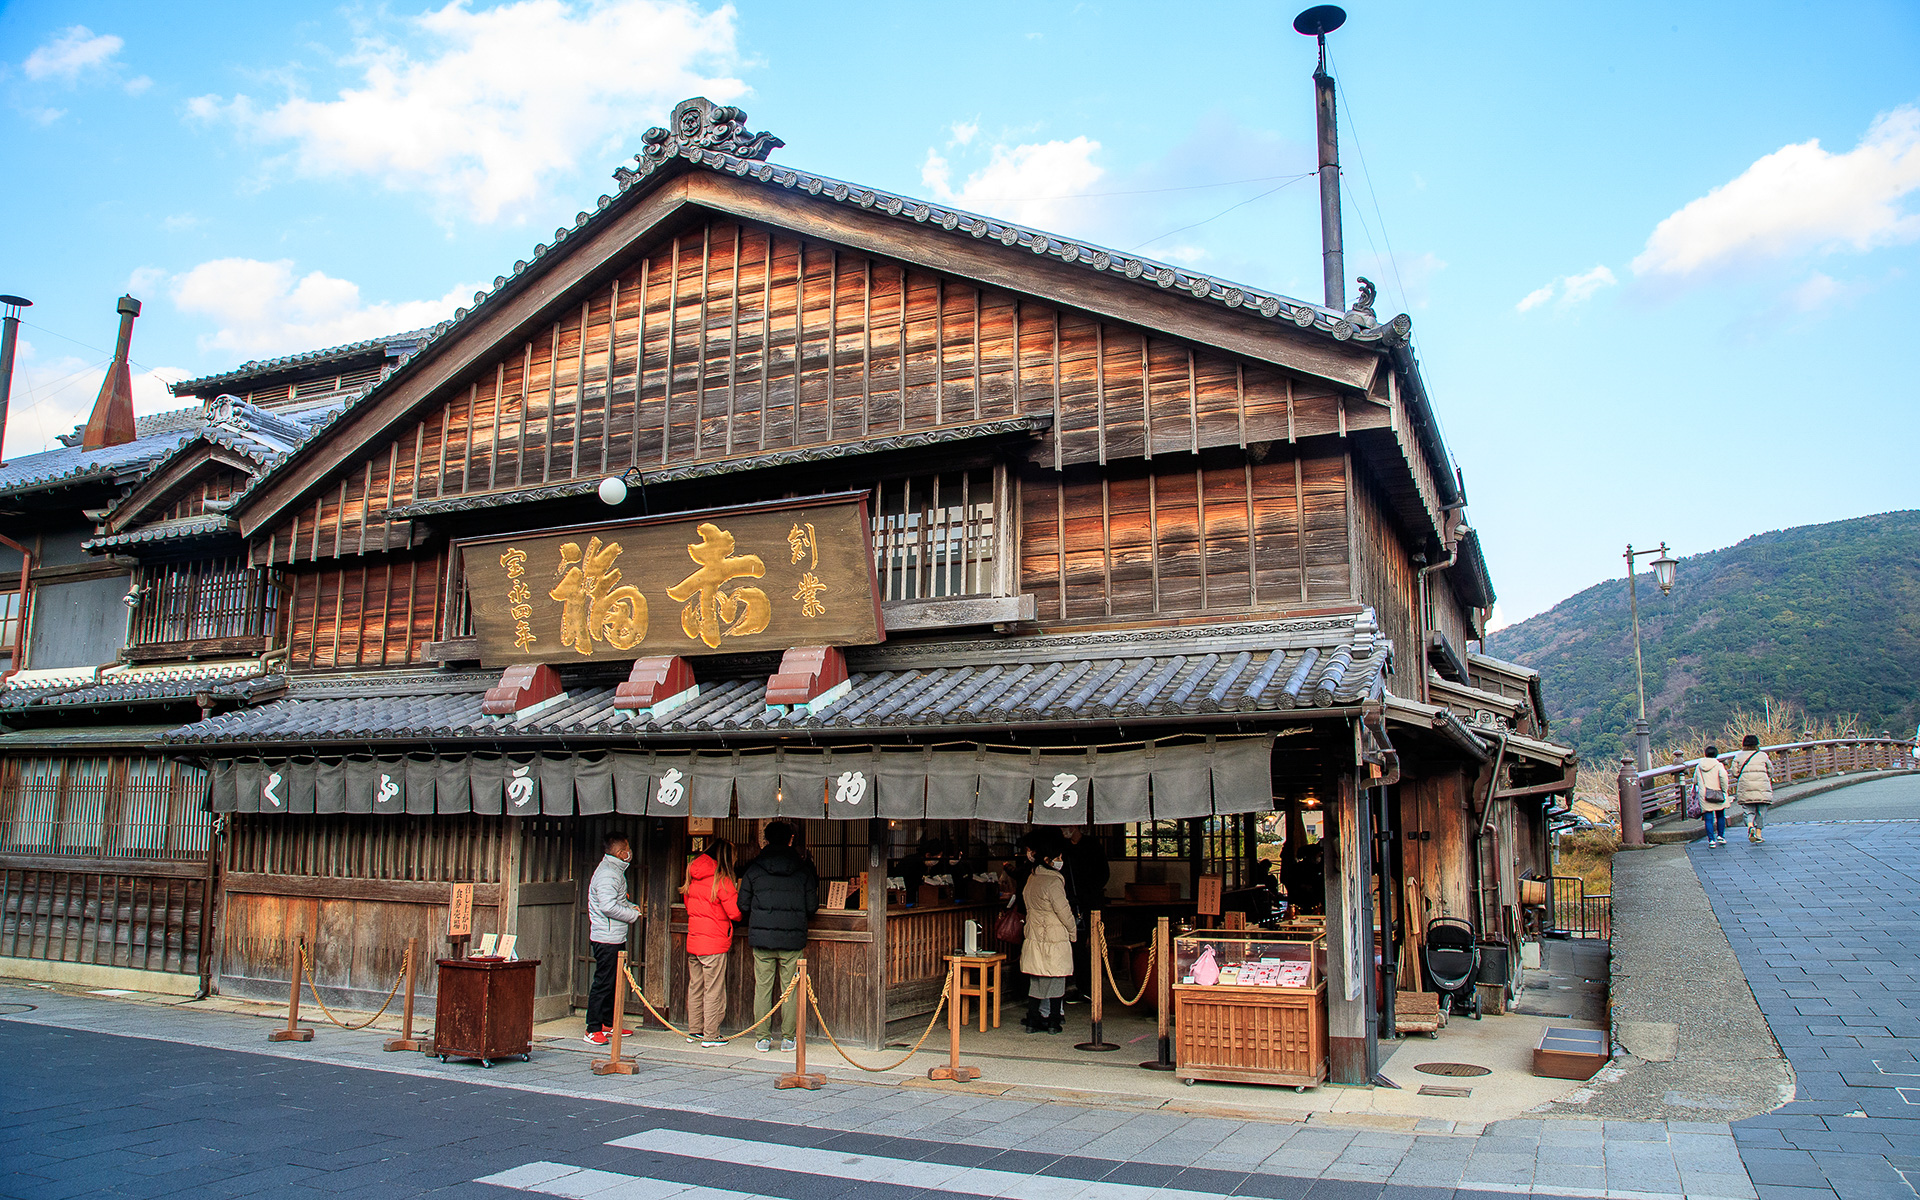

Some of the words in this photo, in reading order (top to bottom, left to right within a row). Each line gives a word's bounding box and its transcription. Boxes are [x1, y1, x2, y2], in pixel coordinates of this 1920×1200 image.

[500, 547, 537, 654] 宝永四年
[549, 522, 772, 656] 赤福
